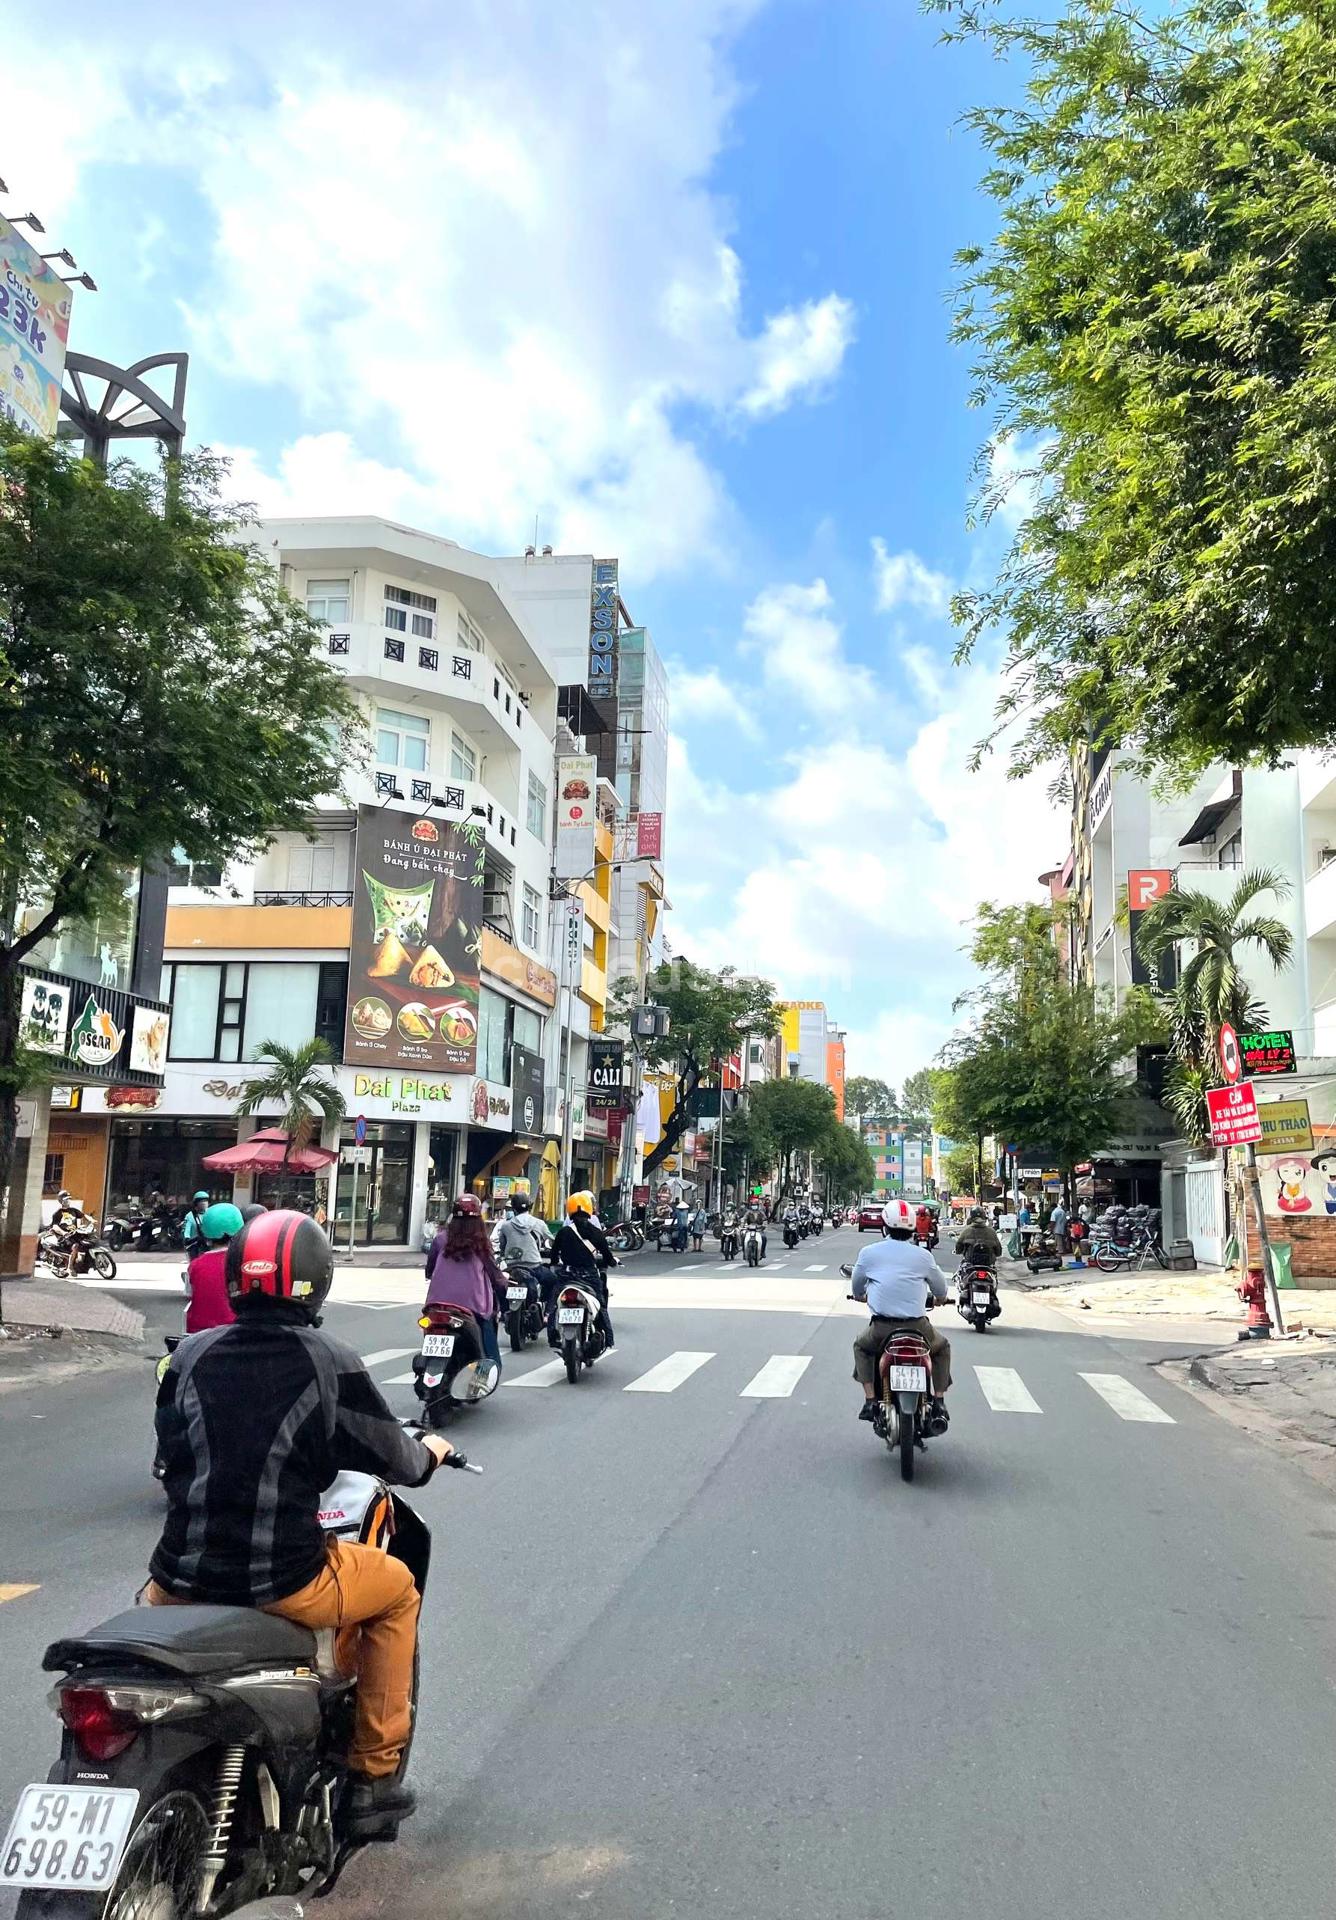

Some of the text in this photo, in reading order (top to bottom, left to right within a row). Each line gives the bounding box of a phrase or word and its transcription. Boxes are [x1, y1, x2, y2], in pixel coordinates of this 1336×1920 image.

[80, 1031, 111, 1050] OSCAR
[594, 1068, 620, 1086] CALI
[76, 1772, 110, 1780] HONDA
[30, 1792, 116, 1835] 59-M1
[3, 1837, 115, 1881] 698.63
